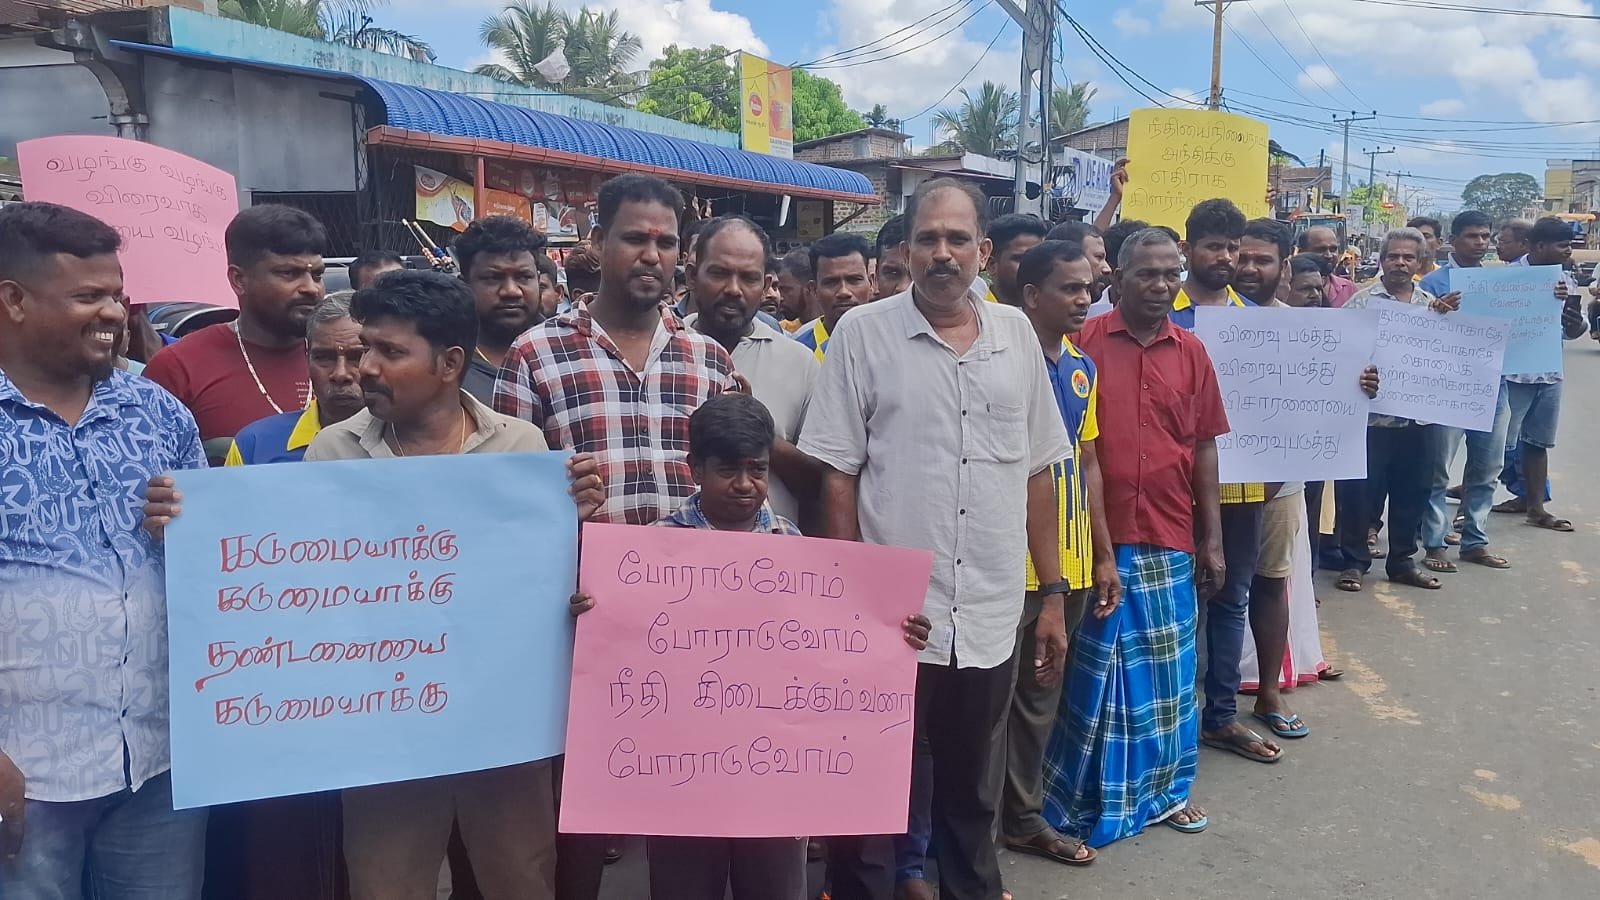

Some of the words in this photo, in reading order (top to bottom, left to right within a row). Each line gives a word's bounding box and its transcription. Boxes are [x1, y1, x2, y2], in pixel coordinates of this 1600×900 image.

[47, 150, 147, 181] வழங்கு
[160, 165, 227, 200] வழங்கு
[1151, 167, 1226, 189] எதிராக
[86, 185, 207, 223] விரைவாக
[1219, 325, 1280, 352] விரைவு
[1289, 327, 1341, 352] படுத்து
[1219, 359, 1282, 385] விரைவு
[220, 525, 459, 572] கடுமையாக்கு
[217, 570, 456, 614] கடுமையாக்கு
[618, 550, 845, 604] போராடுவோம்
[195, 633, 447, 692] தண்டனையை
[647, 612, 868, 663] போராடுவோம்
[215, 672, 448, 726] கடுமையாக்கு
[609, 667, 667, 719] நீதி
[608, 736, 853, 787] போராடுவோம்
